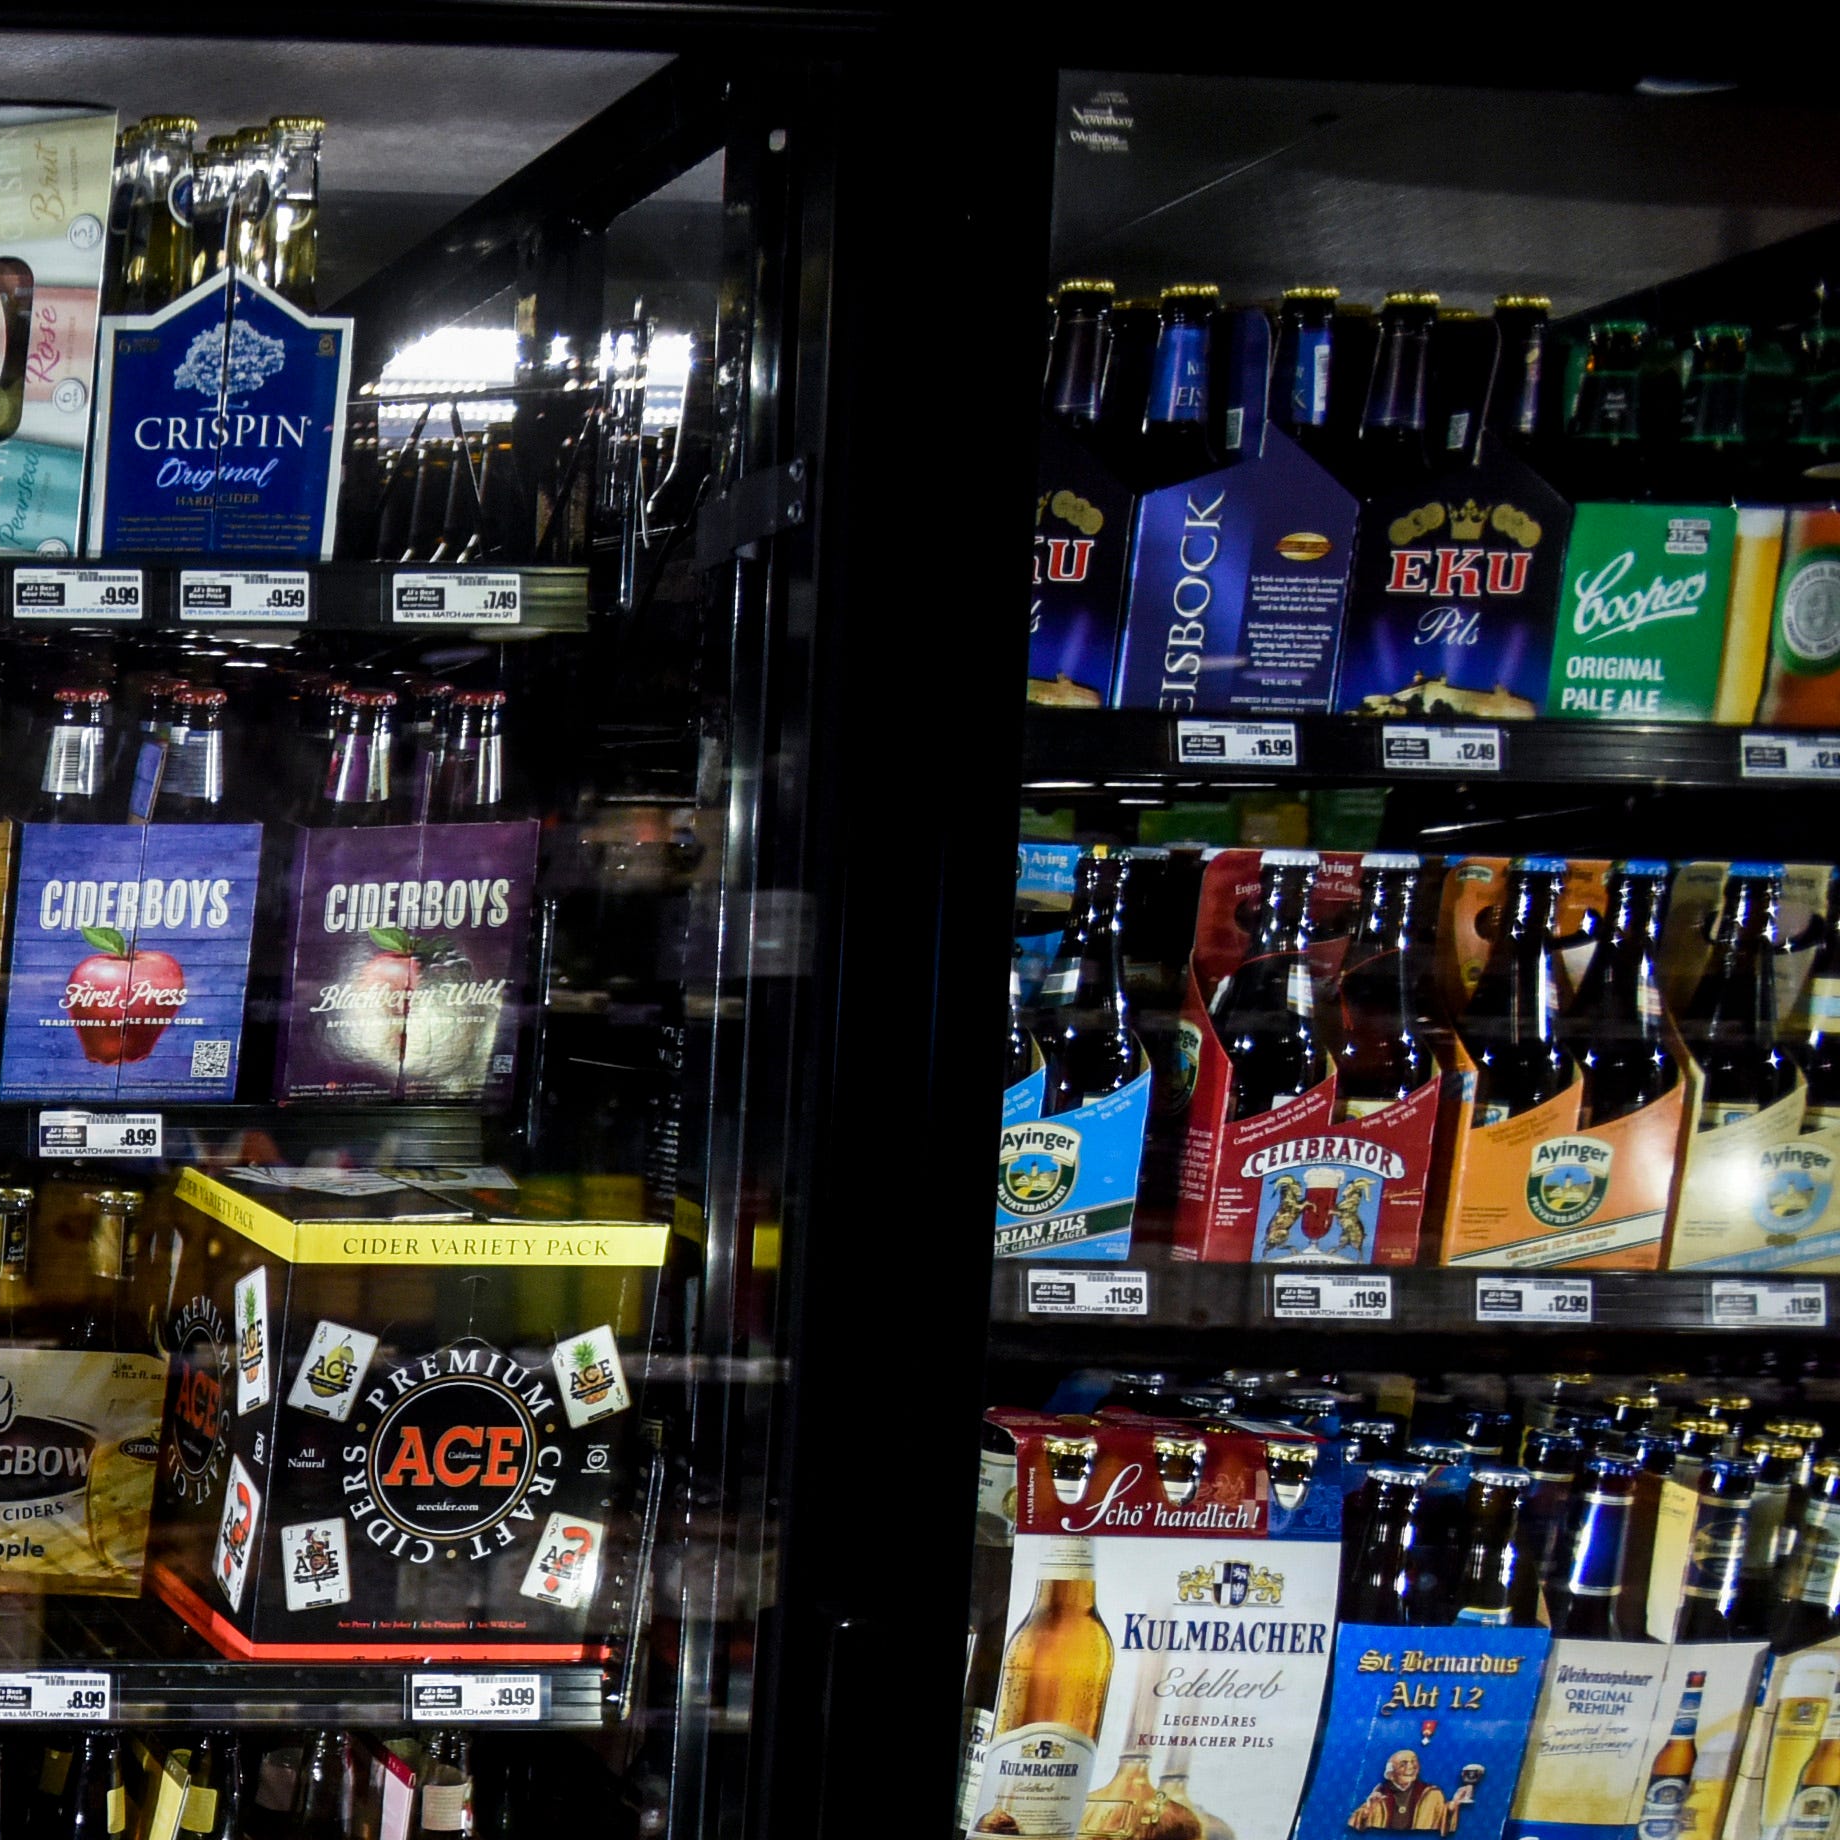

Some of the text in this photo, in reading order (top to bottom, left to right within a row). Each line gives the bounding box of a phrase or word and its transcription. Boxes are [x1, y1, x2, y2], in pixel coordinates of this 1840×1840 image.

[134, 416, 308, 451] CRISPIN
[155, 457, 280, 490] Original
[1385, 549, 1533, 599] EKU
[1573, 551, 1709, 643] Coopers
[1413, 604, 1481, 649] Pils
[1565, 656, 1665, 683] ORIGINAL
[1560, 687, 1659, 713] PALE ALE
[39, 878, 231, 931] CIDERBOYS
[58, 981, 189, 1010] First Press
[121, 1128, 157, 1147] $8.99
[1247, 1140, 1398, 1177] CELEBRATOR
[1534, 1140, 1610, 1166] Ayinger
[342, 1237, 611, 1257] CIDER VARIETY PACK
[287, 1458, 326, 1469] Natural
[298, 1448, 315, 1460] All
[381, 1425, 524, 1486] ACE
[415, 1502, 479, 1512] acecider.com
[1154, 1504, 1260, 1529] handlich!
[1121, 1612, 1329, 1655] KULMBACHER
[1358, 1647, 1521, 1675] St. Bernardus
[1150, 1667, 1287, 1703] Edelherb
[1390, 1680, 1486, 1711] Abt 12
[1162, 1712, 1257, 1730] LEGENDÄRES
[1137, 1731, 1275, 1750] KULMBACHER PILS
